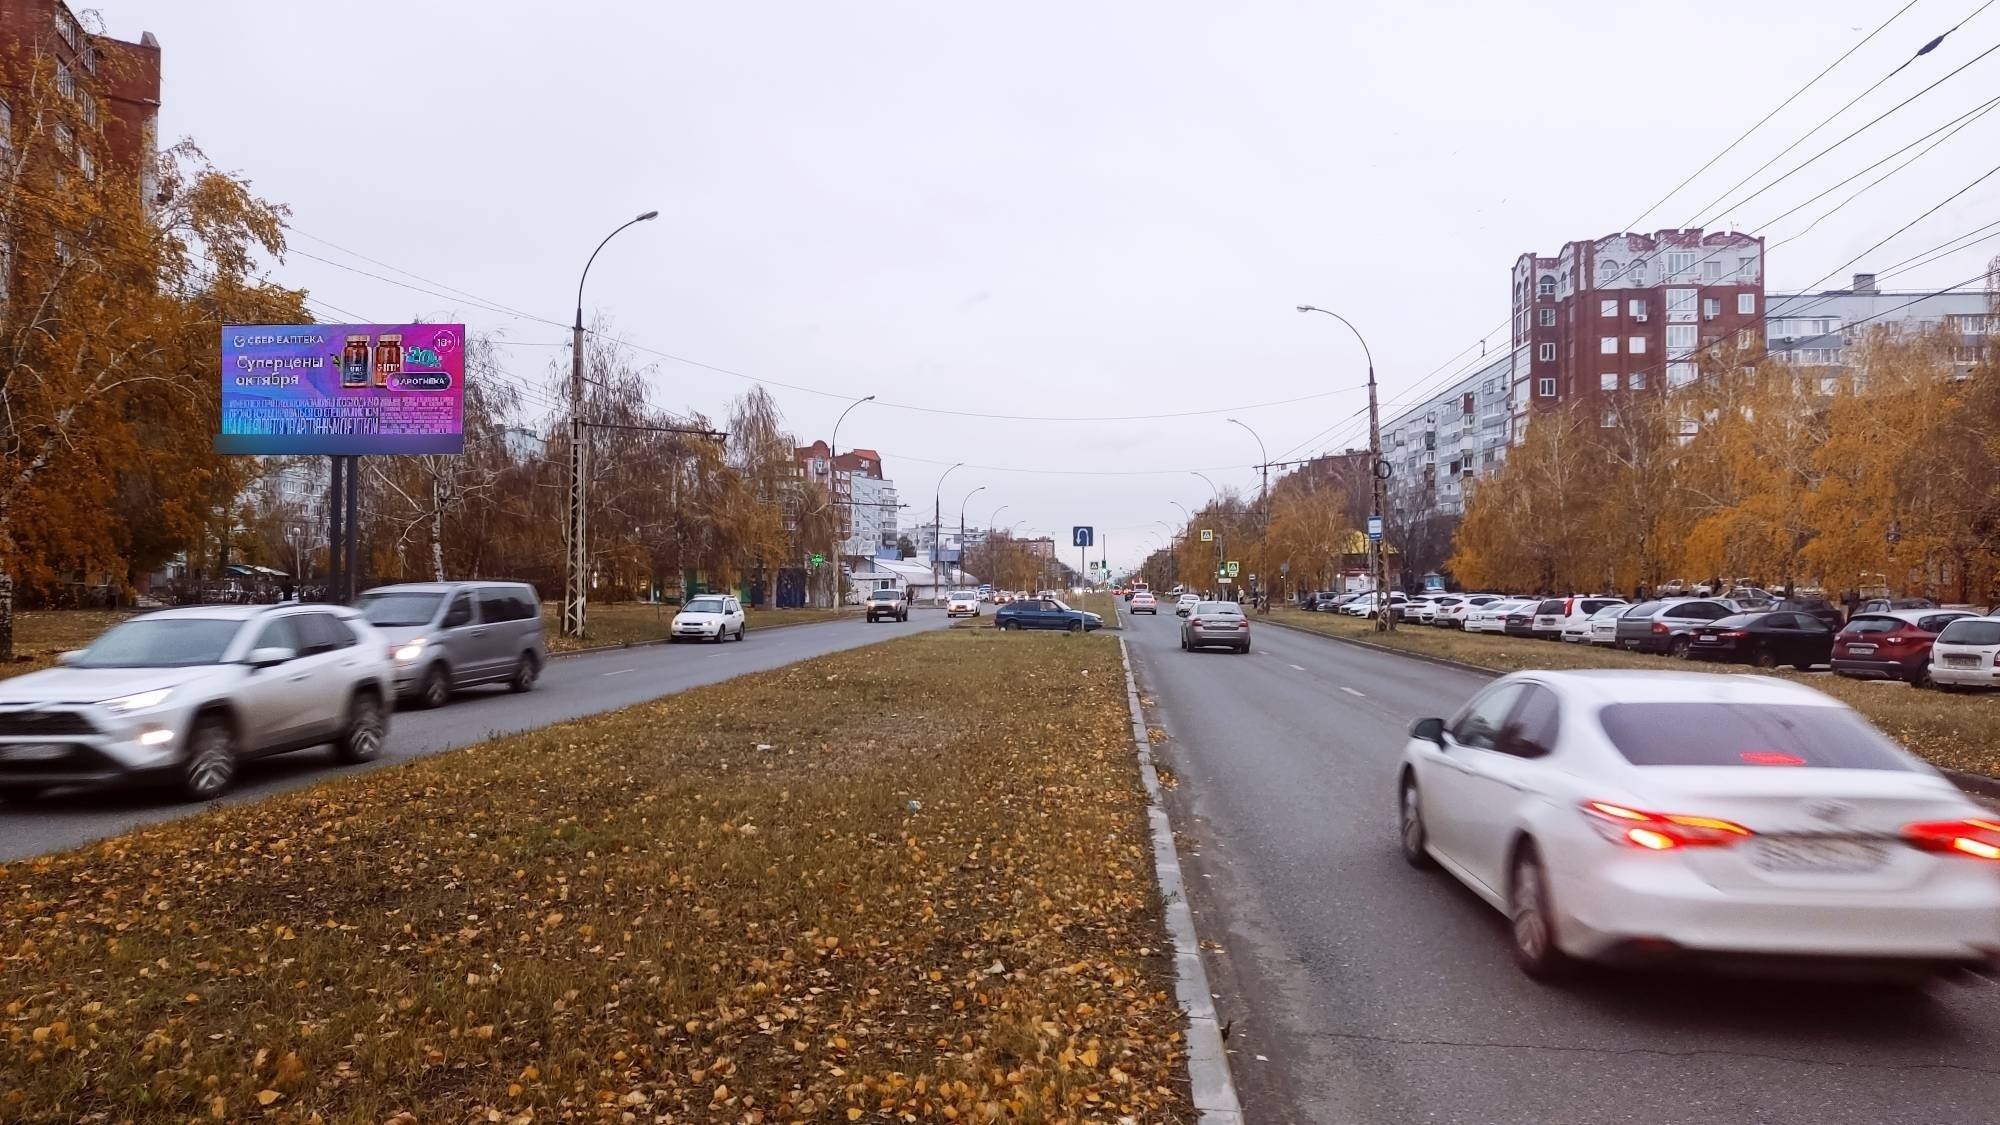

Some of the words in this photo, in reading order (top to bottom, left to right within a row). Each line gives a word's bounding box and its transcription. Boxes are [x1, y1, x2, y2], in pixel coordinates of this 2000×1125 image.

[247, 335, 275, 345] СБЕР
[276, 335, 324, 344] ЕАПТЕКА
[437, 338, 453, 347] 18+
[236, 355, 324, 373] Суперцены
[235, 372, 299, 389] октября
